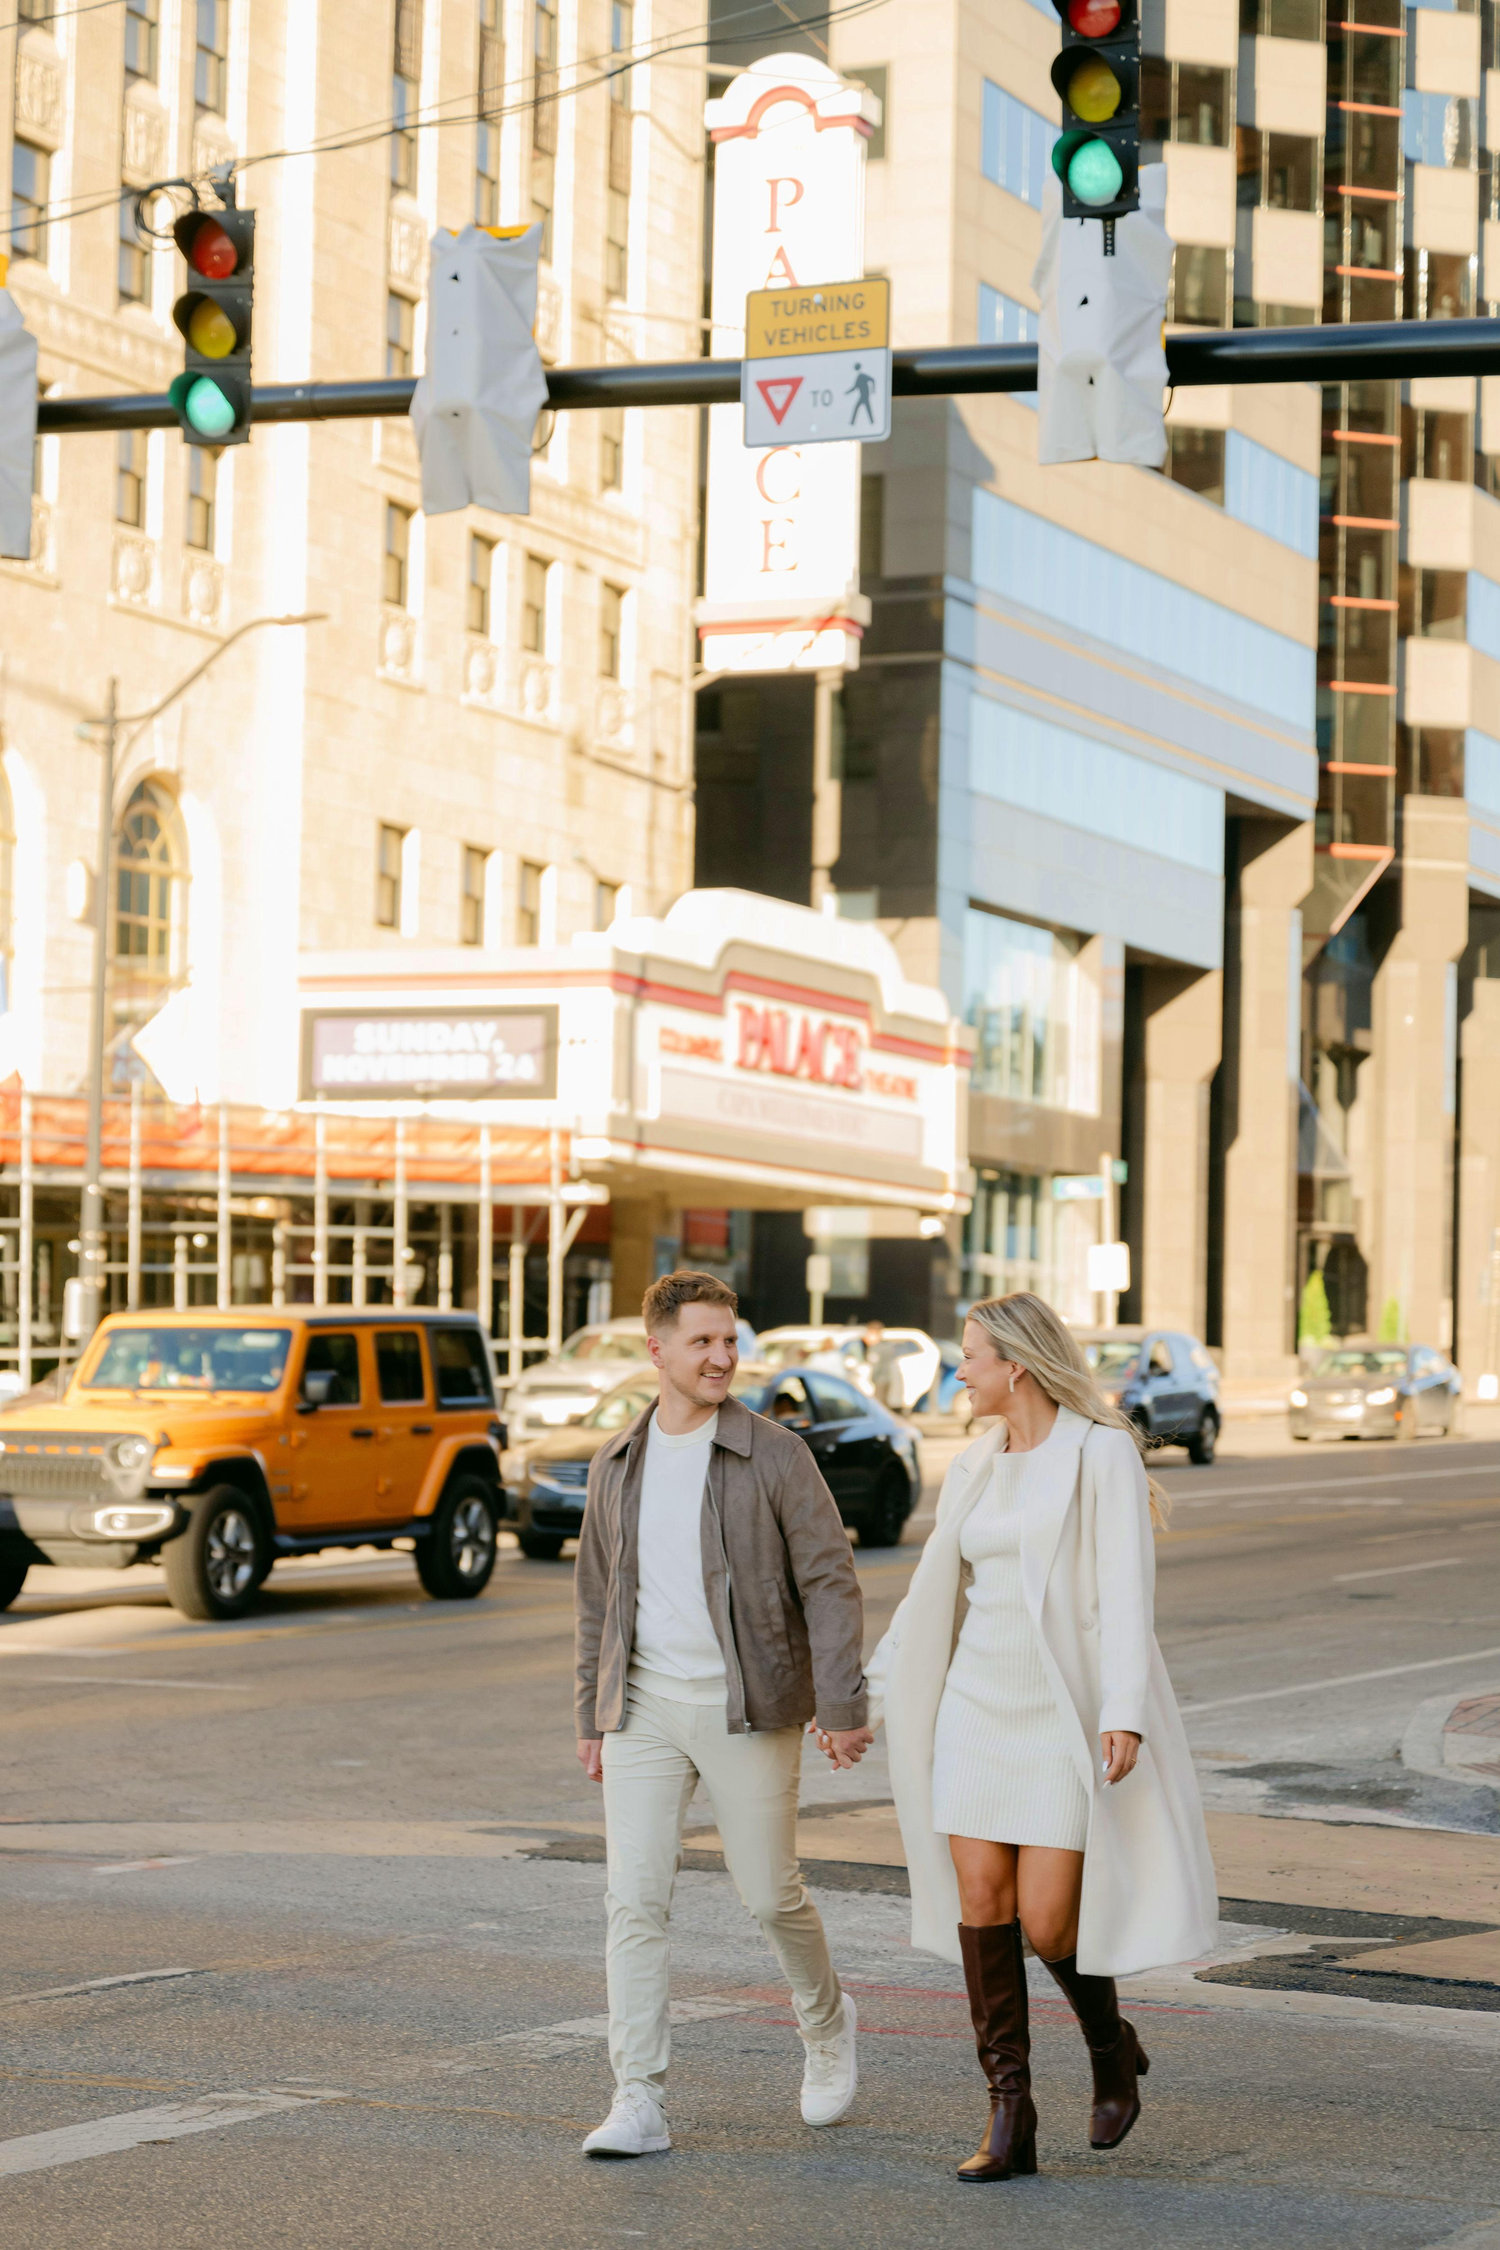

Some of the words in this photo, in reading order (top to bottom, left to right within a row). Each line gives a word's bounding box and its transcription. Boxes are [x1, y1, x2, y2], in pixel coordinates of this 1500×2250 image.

[771, 293, 865, 316] TURNING
[764, 321, 870, 346] VEHICLES
[756, 177, 804, 573] PACE
[810, 389, 833, 407] TO
[734, 1001, 863, 1091] PALACE
